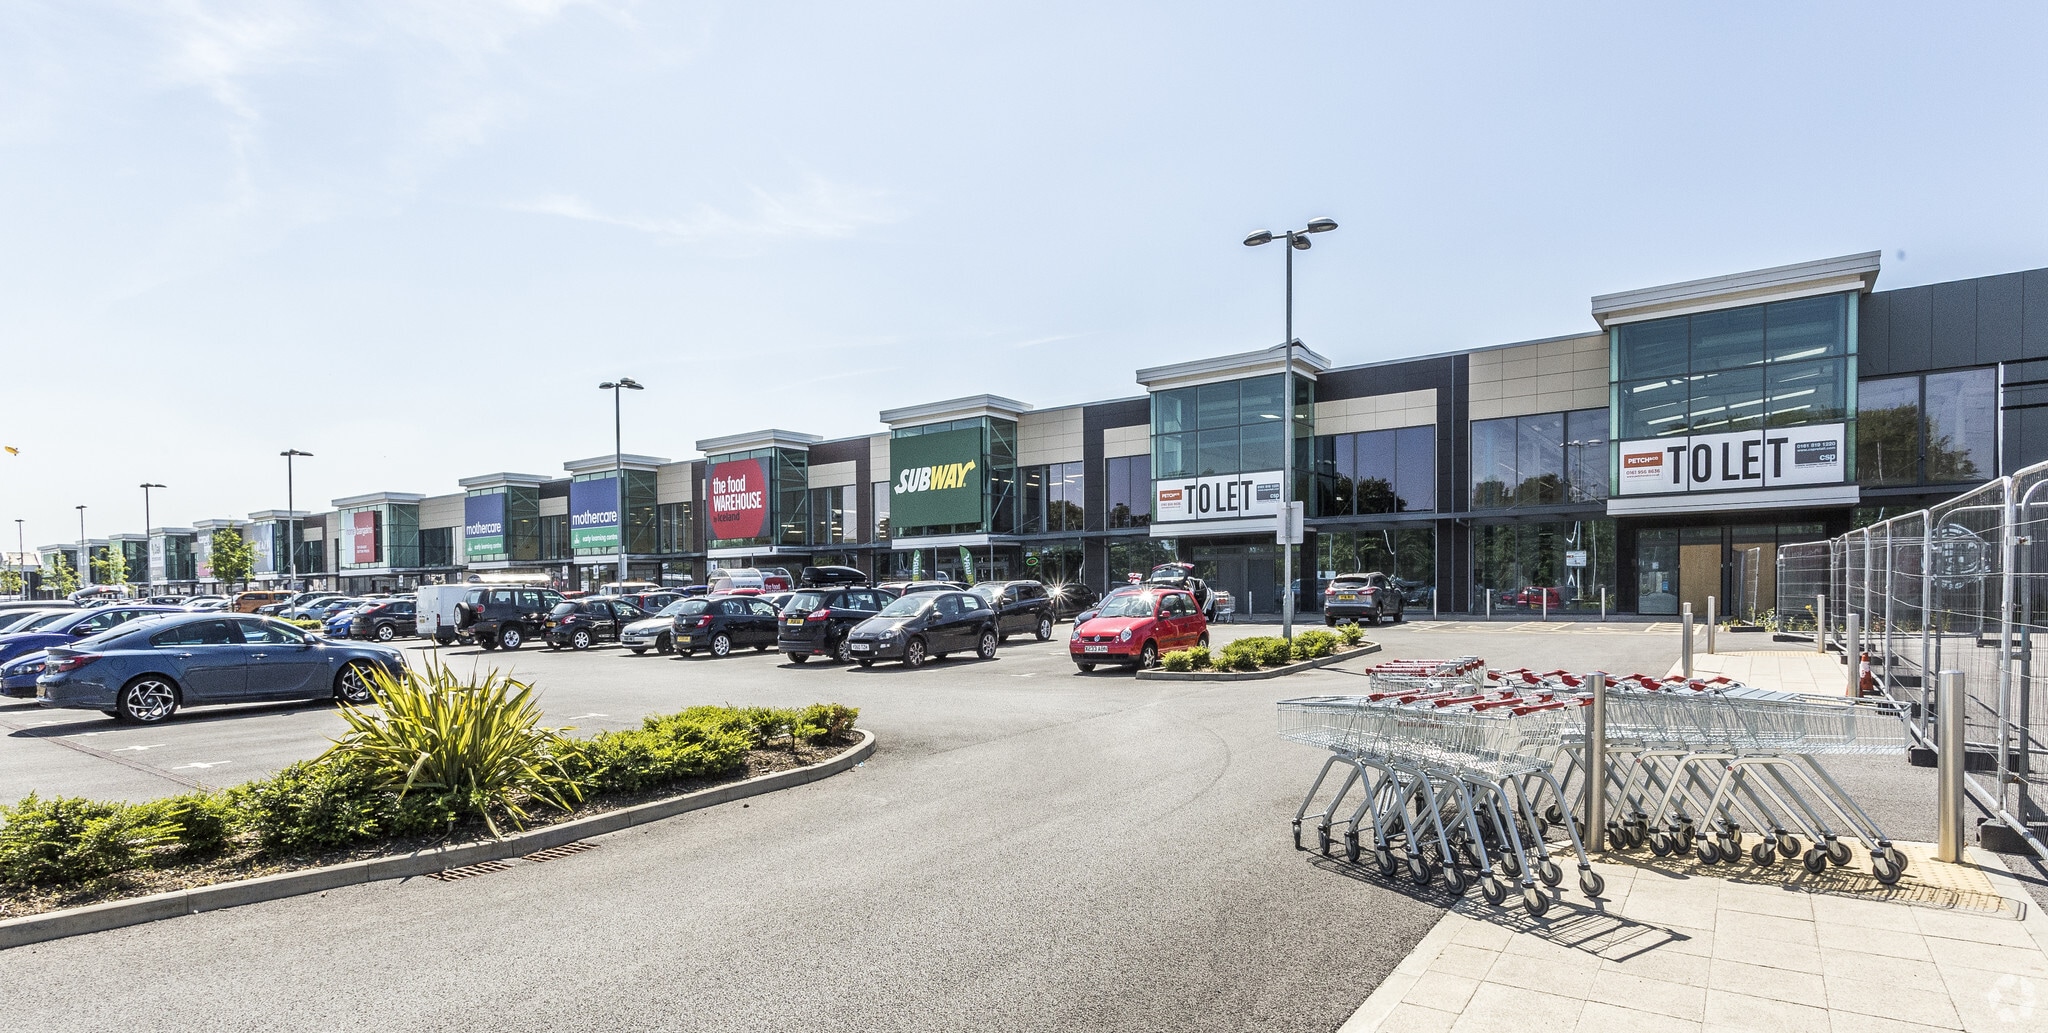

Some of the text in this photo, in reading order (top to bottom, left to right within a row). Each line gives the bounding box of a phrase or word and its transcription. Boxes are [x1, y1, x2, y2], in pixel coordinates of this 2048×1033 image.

[1667, 437, 1789, 484] TO LET
[1819, 453, 1836, 462] csp
[713, 474, 746, 495] the food
[894, 459, 976, 495] SUBWAY
[713, 491, 762, 512] WAREHOUSE
[1184, 480, 1253, 514] TO LET
[572, 510, 618, 526] mothercare
[717, 511, 740, 522] Iceland
[466, 521, 502, 535] mothercare
